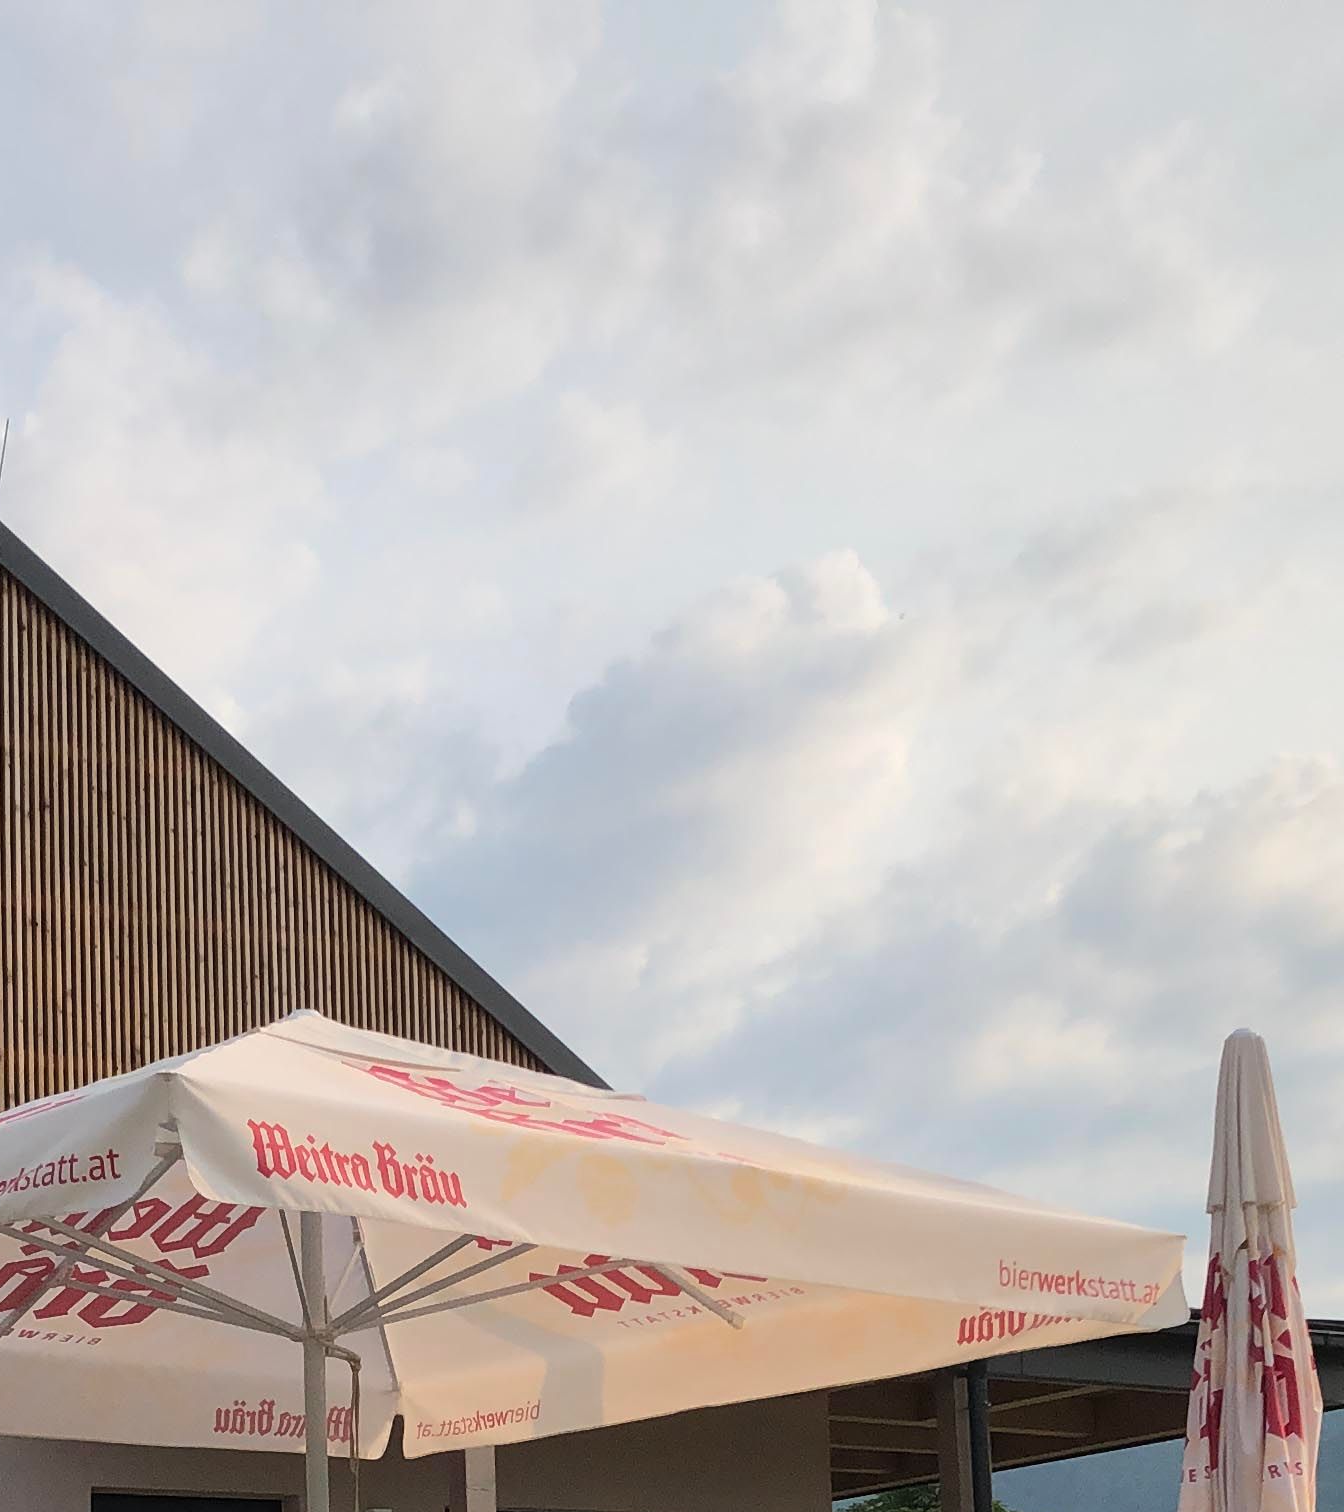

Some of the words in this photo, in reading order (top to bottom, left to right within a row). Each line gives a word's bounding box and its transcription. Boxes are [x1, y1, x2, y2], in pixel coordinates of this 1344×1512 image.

[247, 1119, 377, 1193] Weitra
[372, 1141, 467, 1208] Bräu
[999, 1259, 1160, 1305] bierwerkstatt.at
